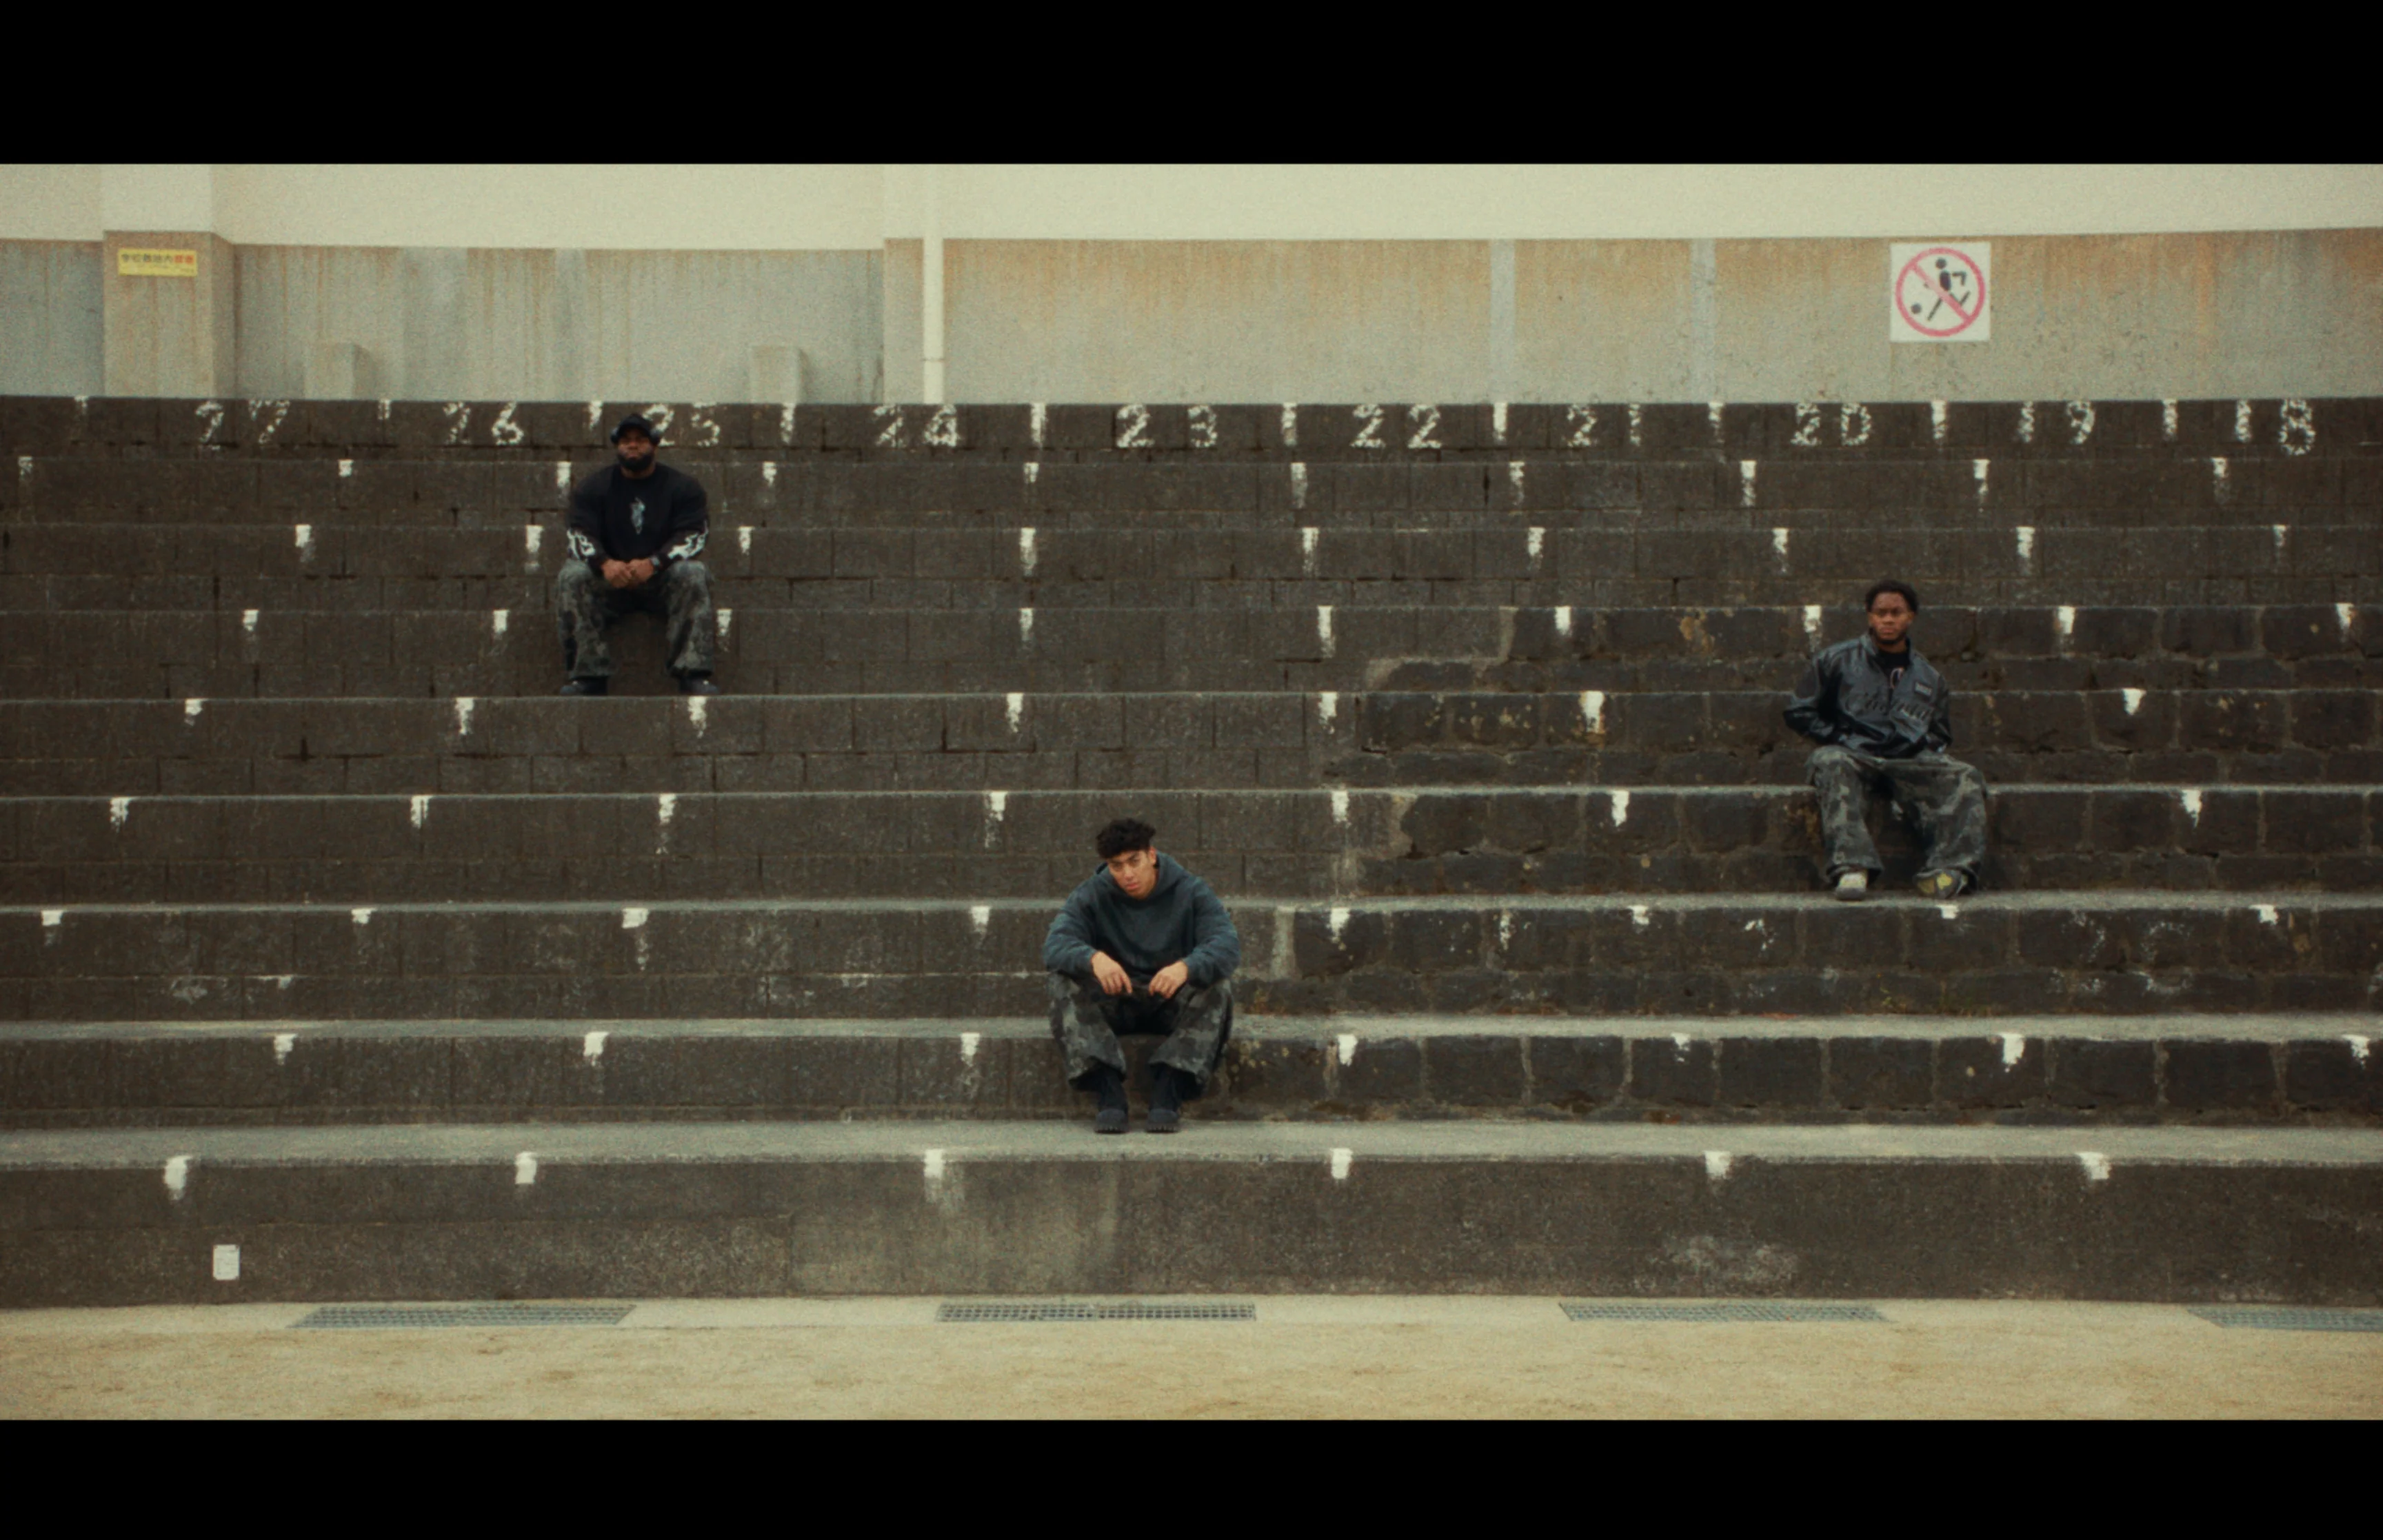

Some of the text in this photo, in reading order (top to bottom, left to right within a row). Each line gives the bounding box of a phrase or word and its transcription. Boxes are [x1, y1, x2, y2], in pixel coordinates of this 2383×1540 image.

[643, 403, 721, 447] 25
[872, 403, 961, 448] 24
[1116, 404, 1218, 448] 23
[1350, 404, 1443, 449] 22
[1566, 403, 1642, 447] 21
[1791, 402, 1872, 447] 20
[2018, 401, 2095, 444] 19
[2235, 398, 2316, 456] 18
